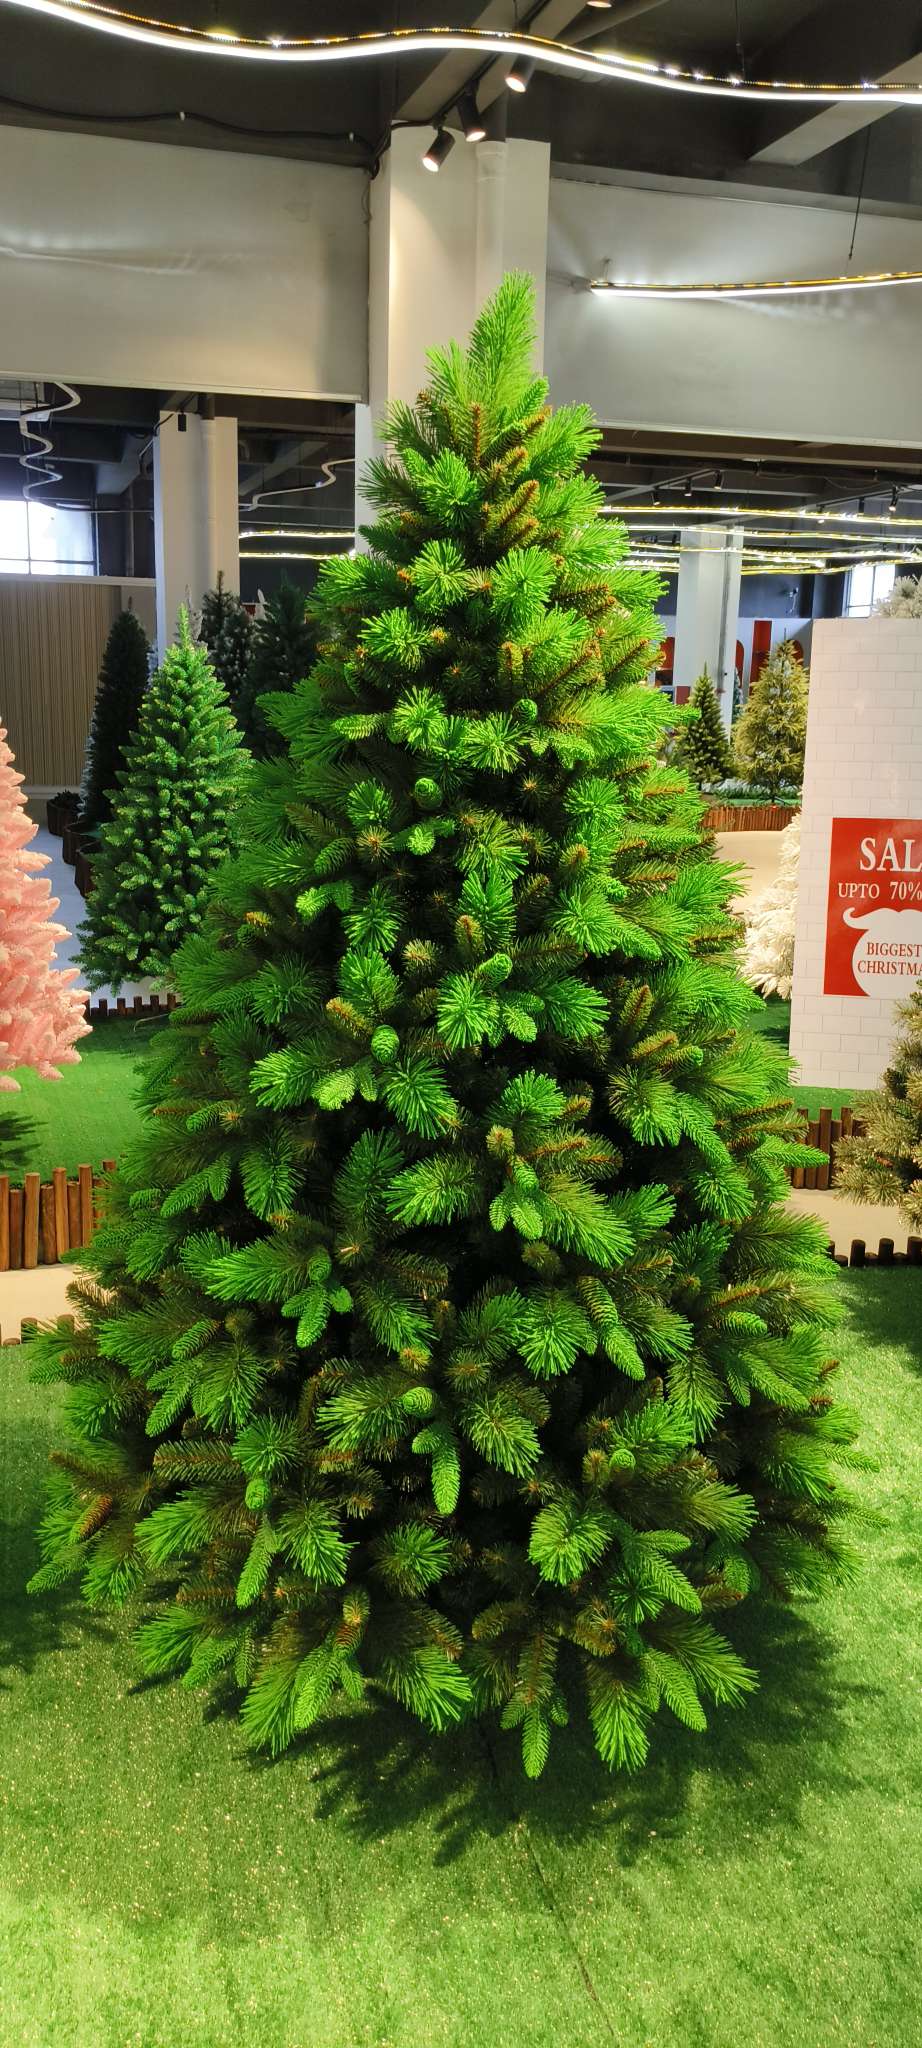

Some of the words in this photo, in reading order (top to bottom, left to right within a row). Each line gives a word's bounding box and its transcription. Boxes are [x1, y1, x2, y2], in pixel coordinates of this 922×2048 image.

[860, 837, 922, 872] SAL
[838, 882, 880, 899] UPTO
[889, 881, 922, 901] 70%
[867, 942, 922, 958] BIGGEST
